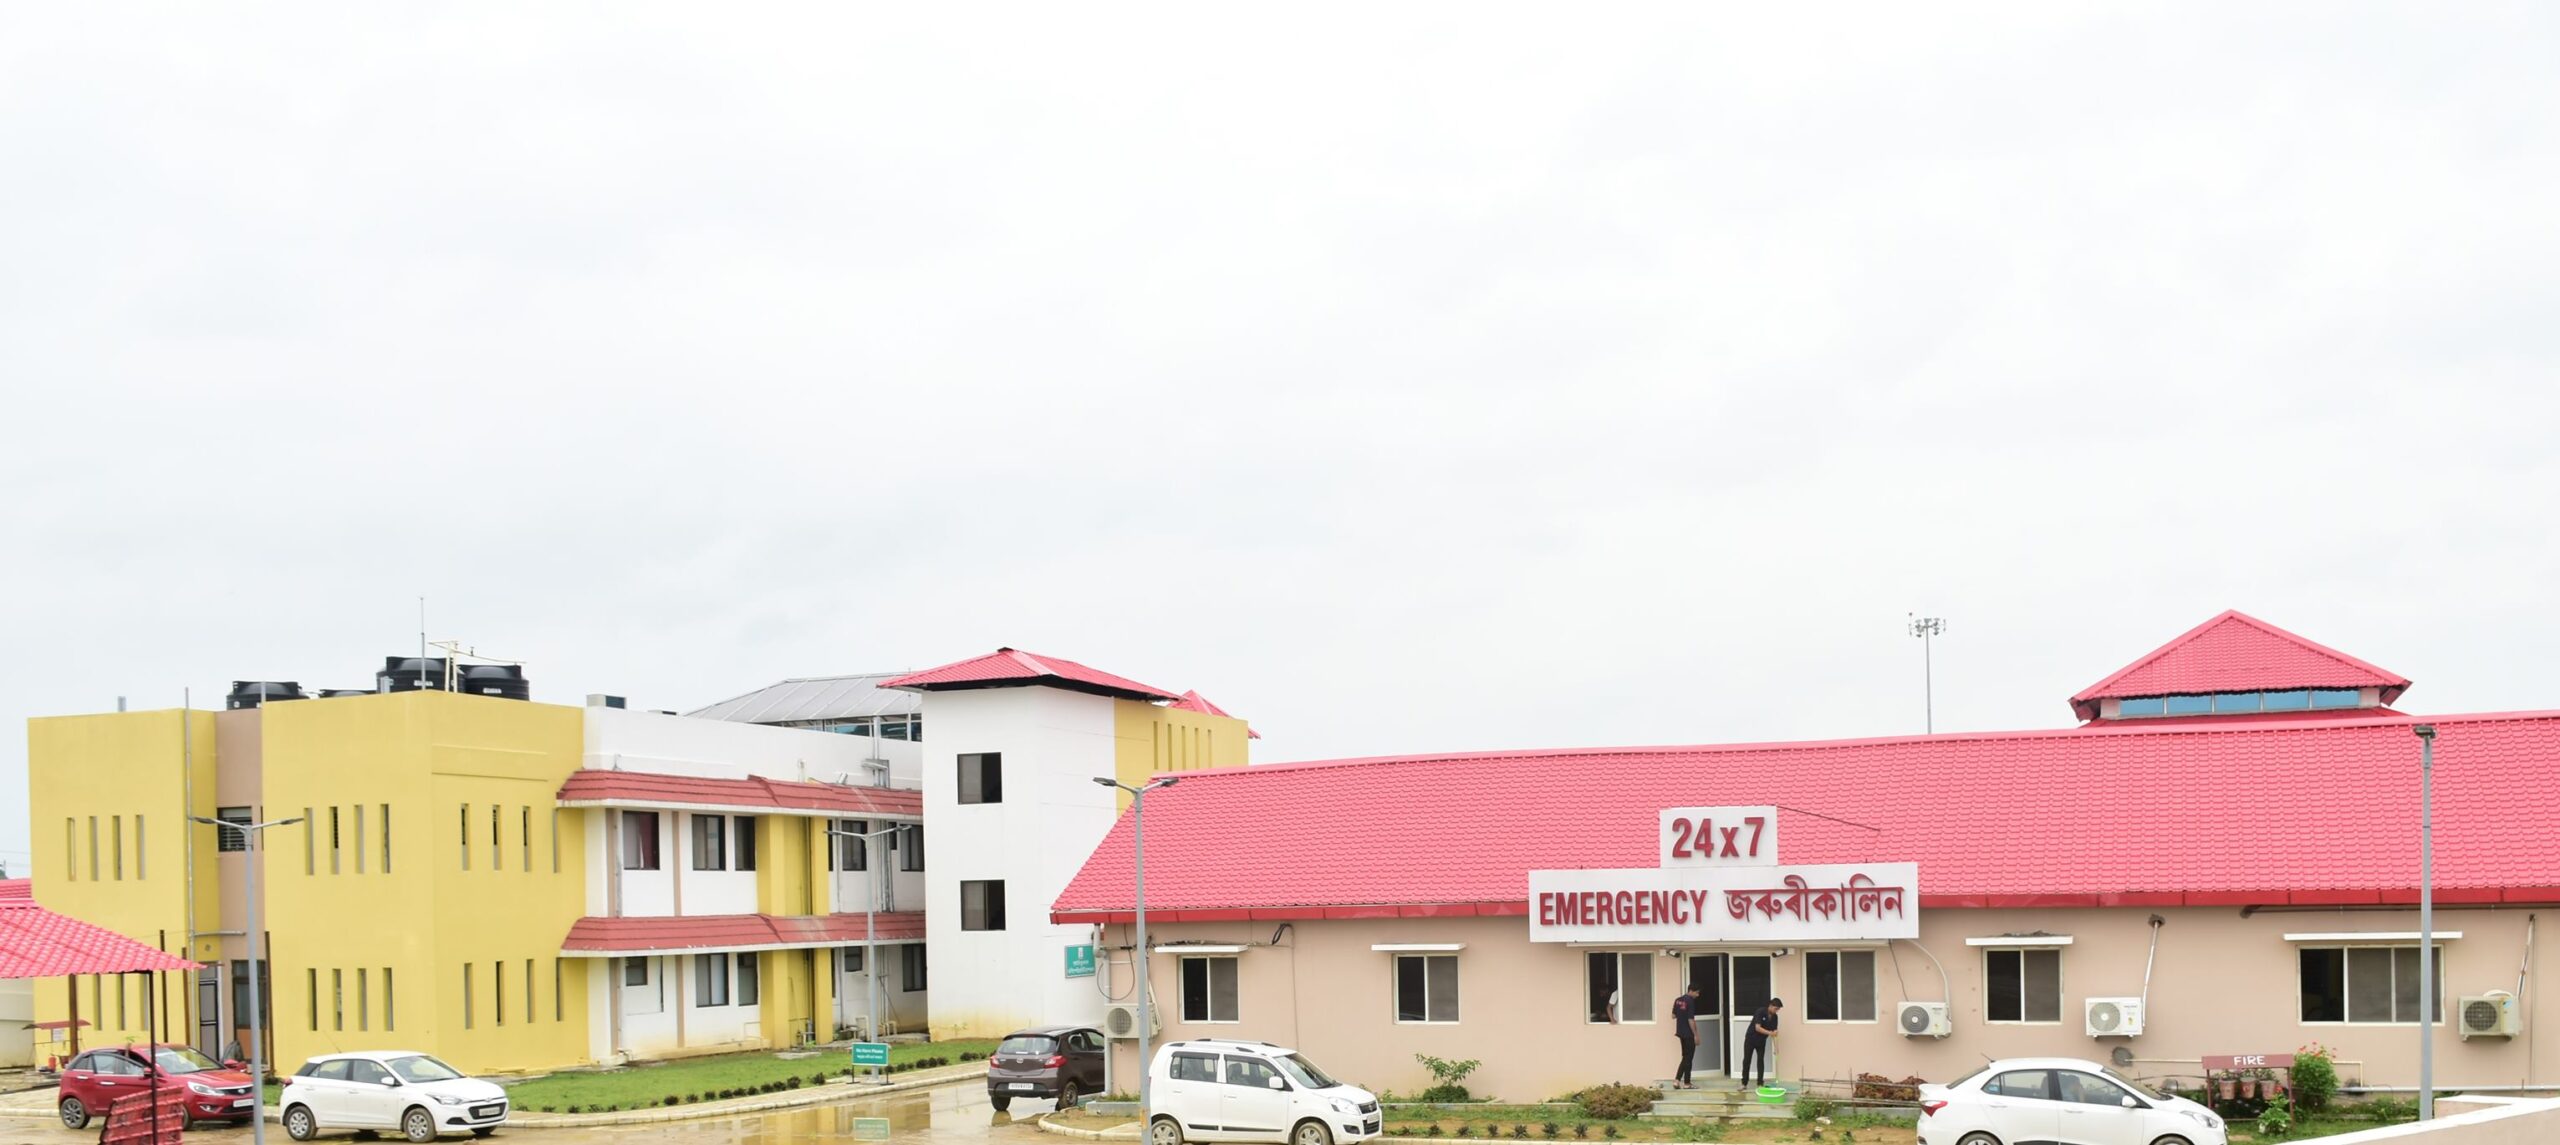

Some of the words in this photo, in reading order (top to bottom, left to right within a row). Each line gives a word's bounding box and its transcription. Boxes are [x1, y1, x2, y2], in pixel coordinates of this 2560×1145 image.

[1540, 890, 1707, 926] EMERGENCY
[1724, 874, 1905, 922] জৰুৰীকালিন
[2233, 1055, 2266, 1066] FIRE
